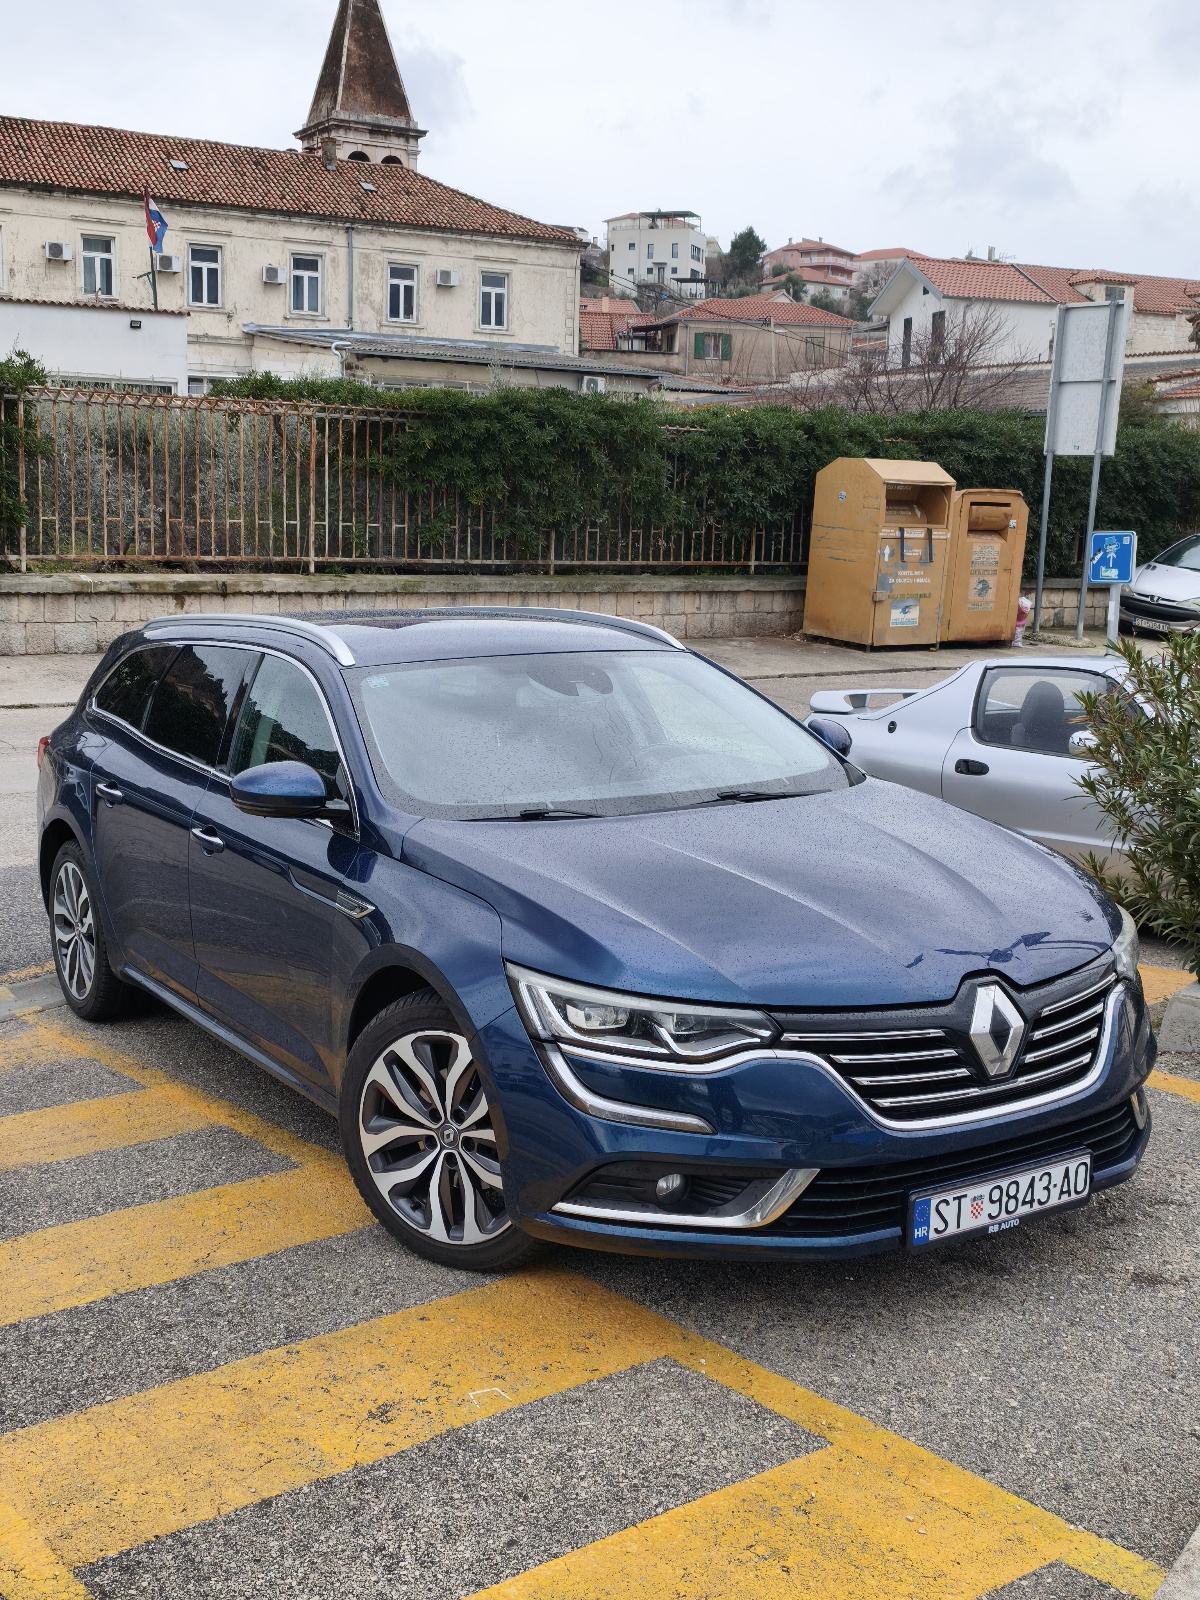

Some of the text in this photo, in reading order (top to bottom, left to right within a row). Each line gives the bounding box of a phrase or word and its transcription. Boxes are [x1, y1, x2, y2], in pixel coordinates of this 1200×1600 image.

[914, 1226, 928, 1239] HR
[934, 1194, 968, 1235] ST
[1000, 1218, 1020, 1231] AUTO
